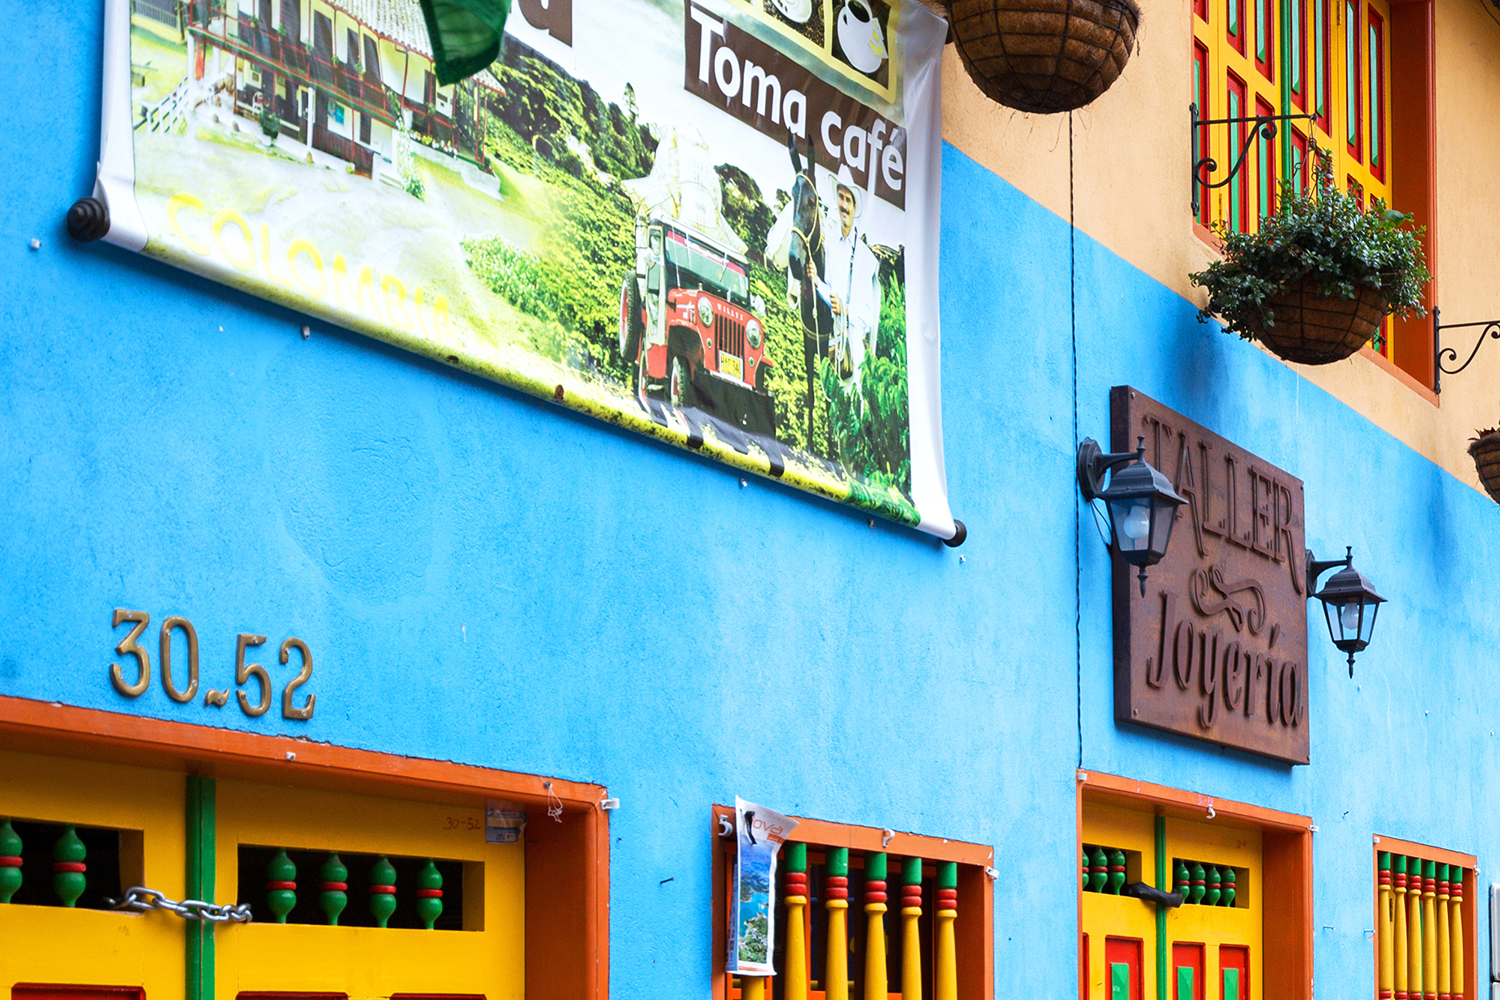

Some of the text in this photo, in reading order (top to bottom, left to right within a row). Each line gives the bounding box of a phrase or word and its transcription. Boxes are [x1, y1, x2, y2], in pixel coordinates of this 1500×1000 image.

[690, 5, 807, 139] Toma
[820, 111, 904, 192] café
[166, 192, 460, 348] COLOMBIA
[1145, 411, 1304, 595] TALLER
[1147, 589, 1304, 729] Joyería
[443, 816, 481, 830] 30-52
